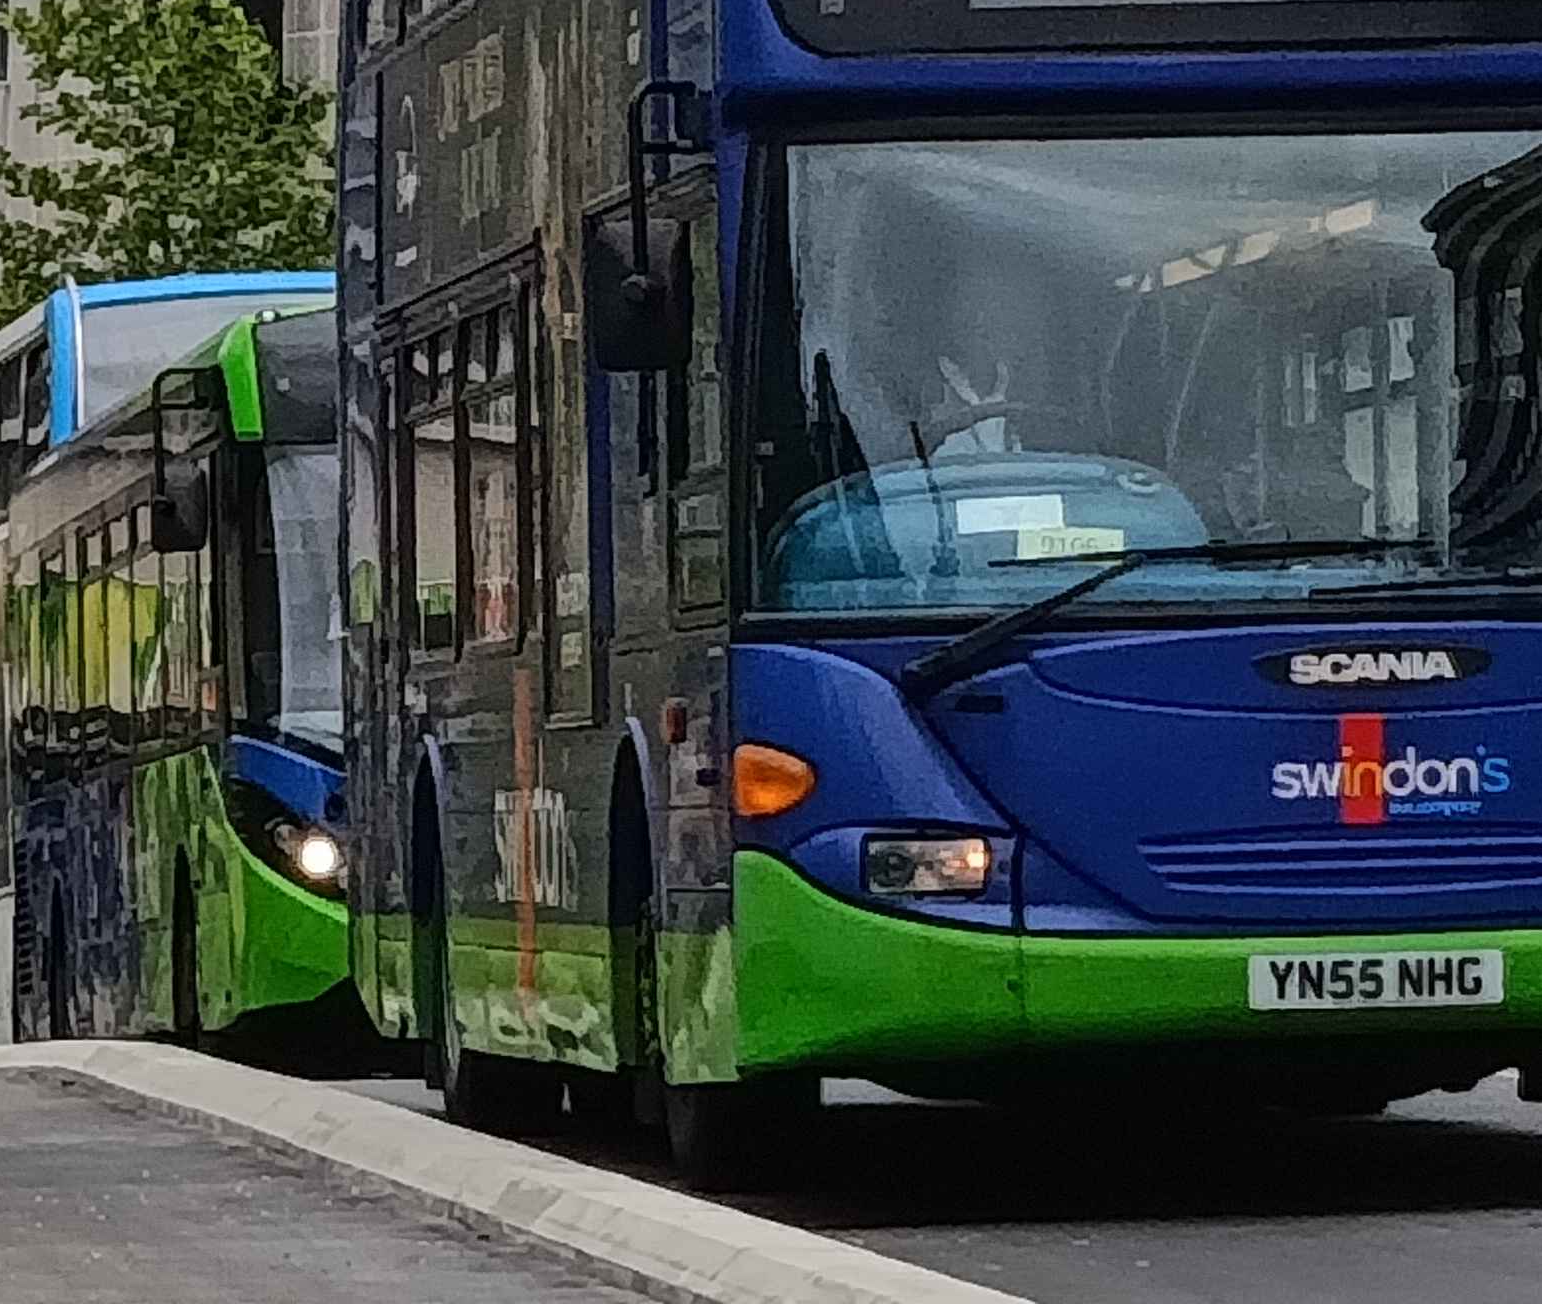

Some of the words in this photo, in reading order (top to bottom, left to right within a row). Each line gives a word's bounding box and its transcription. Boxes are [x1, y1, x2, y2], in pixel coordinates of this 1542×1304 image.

[1289, 651, 1457, 684] SCANIA
[1271, 745, 1512, 799] swindon's
[1269, 958, 1385, 1000] YN55
[1397, 956, 1483, 998] NHG
